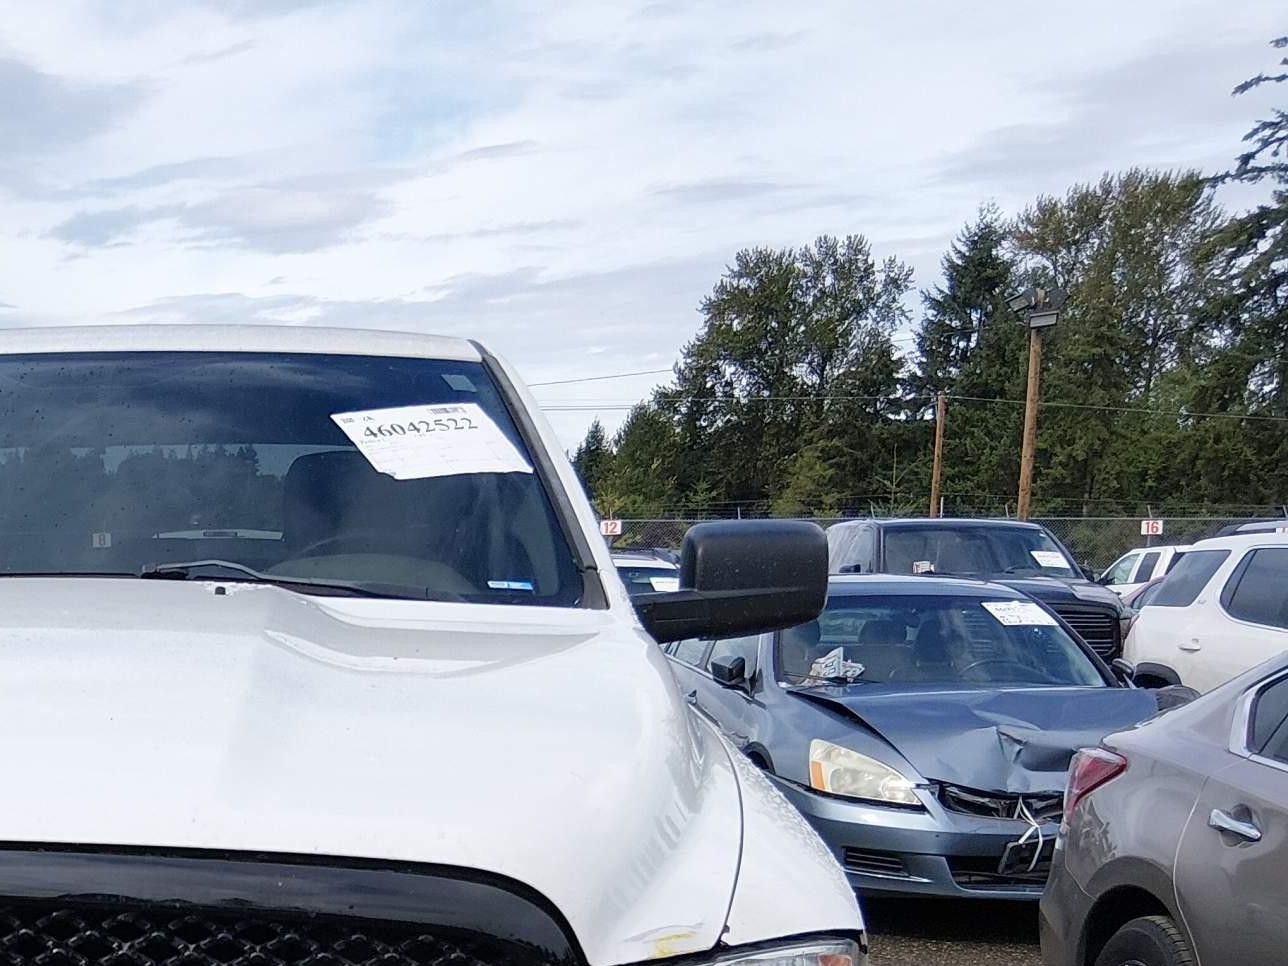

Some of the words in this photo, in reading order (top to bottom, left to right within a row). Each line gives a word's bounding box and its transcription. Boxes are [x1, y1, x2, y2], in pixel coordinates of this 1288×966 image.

[363, 417, 479, 440] 46042522
[604, 521, 617, 534] 12
[1146, 521, 1159, 534] 16
